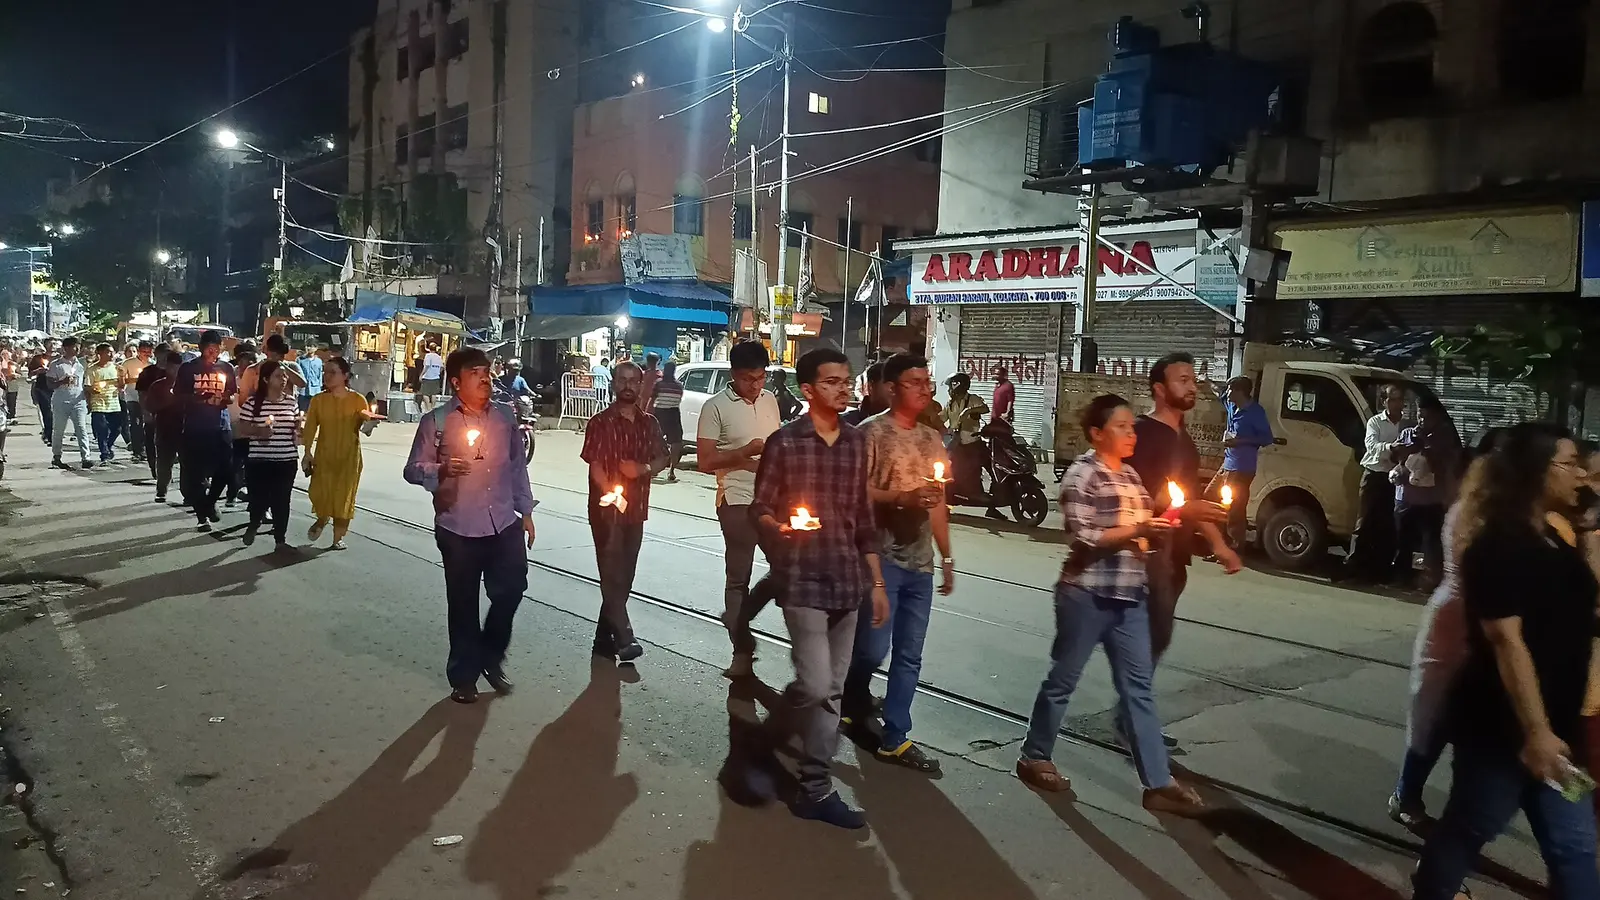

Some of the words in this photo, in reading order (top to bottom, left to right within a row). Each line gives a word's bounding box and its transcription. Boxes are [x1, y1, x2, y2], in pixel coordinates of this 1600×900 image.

[922, 241, 1157, 282] ARADHANA
[993, 292, 1029, 302] KOLKATA
[1035, 291, 1050, 301] 700
